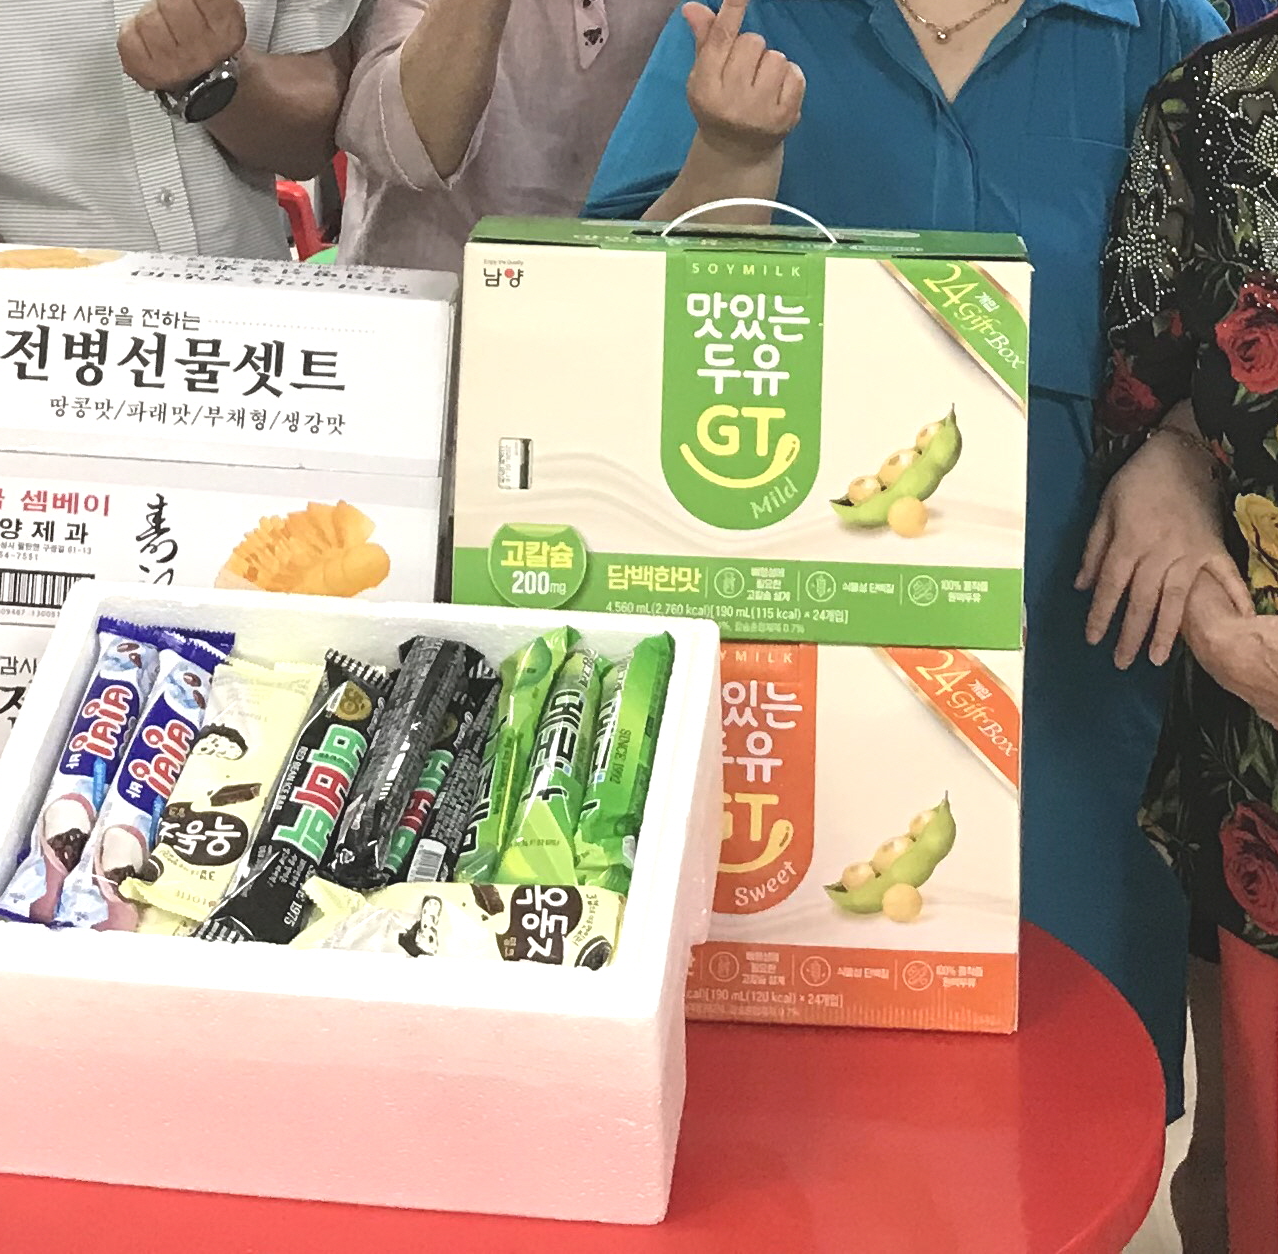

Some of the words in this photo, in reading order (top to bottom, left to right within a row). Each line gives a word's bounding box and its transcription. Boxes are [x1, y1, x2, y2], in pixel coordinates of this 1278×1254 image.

[483, 267, 524, 288] 남양
[692, 262, 801, 277] SOYMILK
[8, 299, 67, 322] 감사와
[73, 305, 134, 327] 사랑을
[142, 308, 201, 331] 전하는
[687, 291, 811, 343] 맛있는
[0, 324, 346, 398] 전병선물셋트
[696, 343, 791, 397] 두유
[49, 395, 346, 436] 땅콩맛/파래맛/부채형/생강맛
[696, 404, 786, 457] GT
[20, 490, 111, 517] 셈베이
[750, 476, 800, 519] Mild
[500, 539, 574, 569] 고칼슘
[512, 570, 567, 595] 200mg
[607, 564, 702, 593] 담백한맛
[722, 679, 803, 729] 있는
[734, 859, 799, 908] Sweet
[284, 895, 304, 928] 1975
